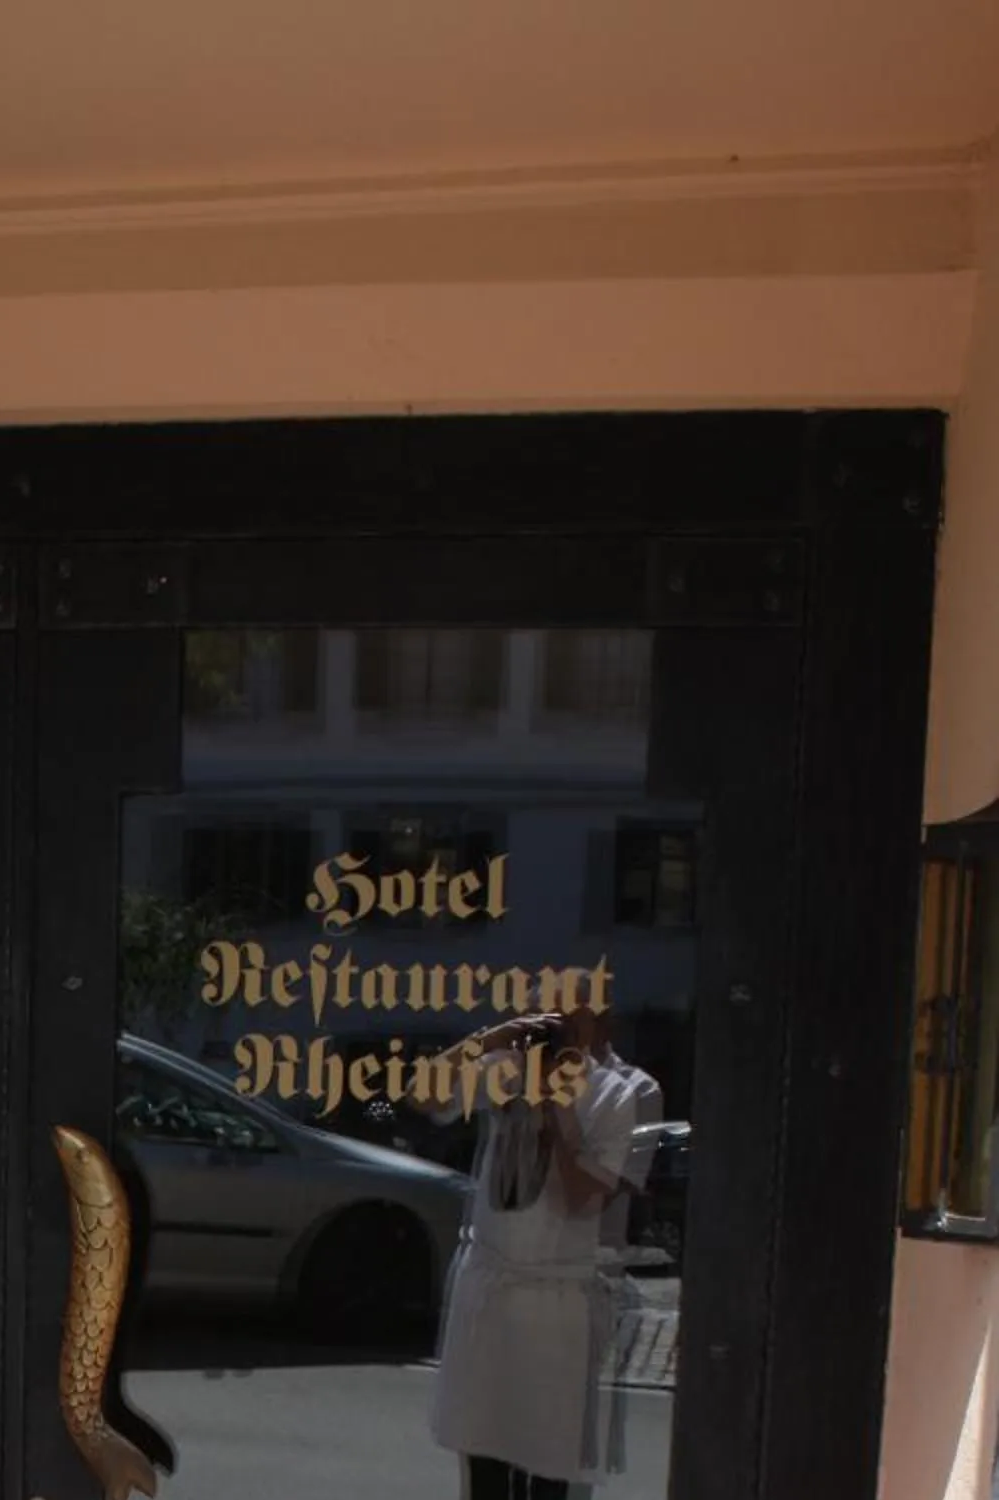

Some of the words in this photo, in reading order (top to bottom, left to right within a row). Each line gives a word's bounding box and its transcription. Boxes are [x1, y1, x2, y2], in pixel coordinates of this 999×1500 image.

[306, 852, 509, 937] Hotel
[201, 940, 615, 1028] Restaurant
[234, 1033, 587, 1123] Rheinfels
